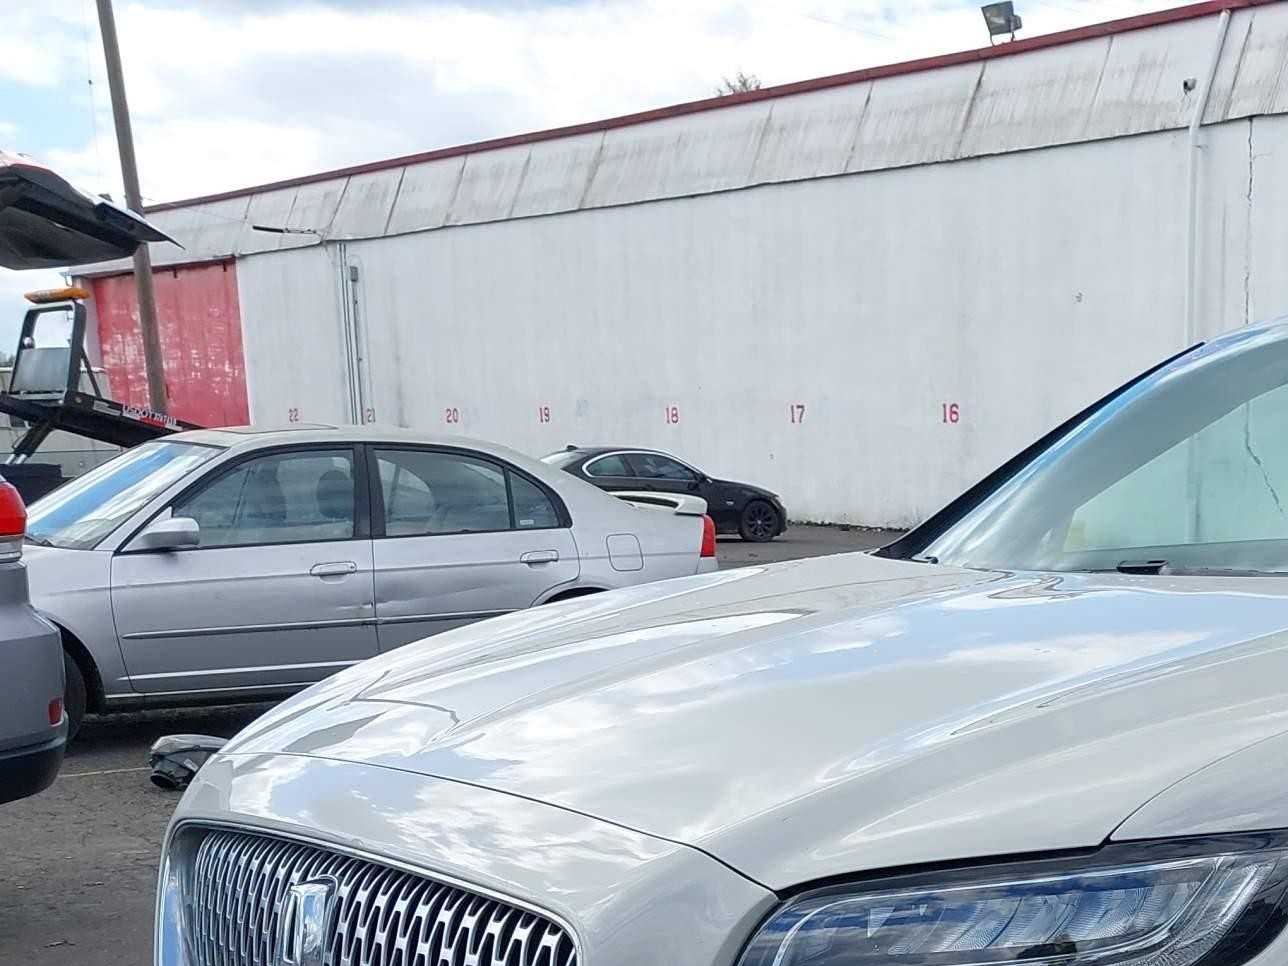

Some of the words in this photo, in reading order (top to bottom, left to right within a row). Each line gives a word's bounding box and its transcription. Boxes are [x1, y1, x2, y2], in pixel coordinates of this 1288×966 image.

[288, 408, 299, 423] 22
[445, 408, 459, 423] 20
[539, 406, 550, 423] 19
[665, 406, 679, 424] 18
[790, 405, 805, 424] 17
[942, 403, 960, 424] 16
